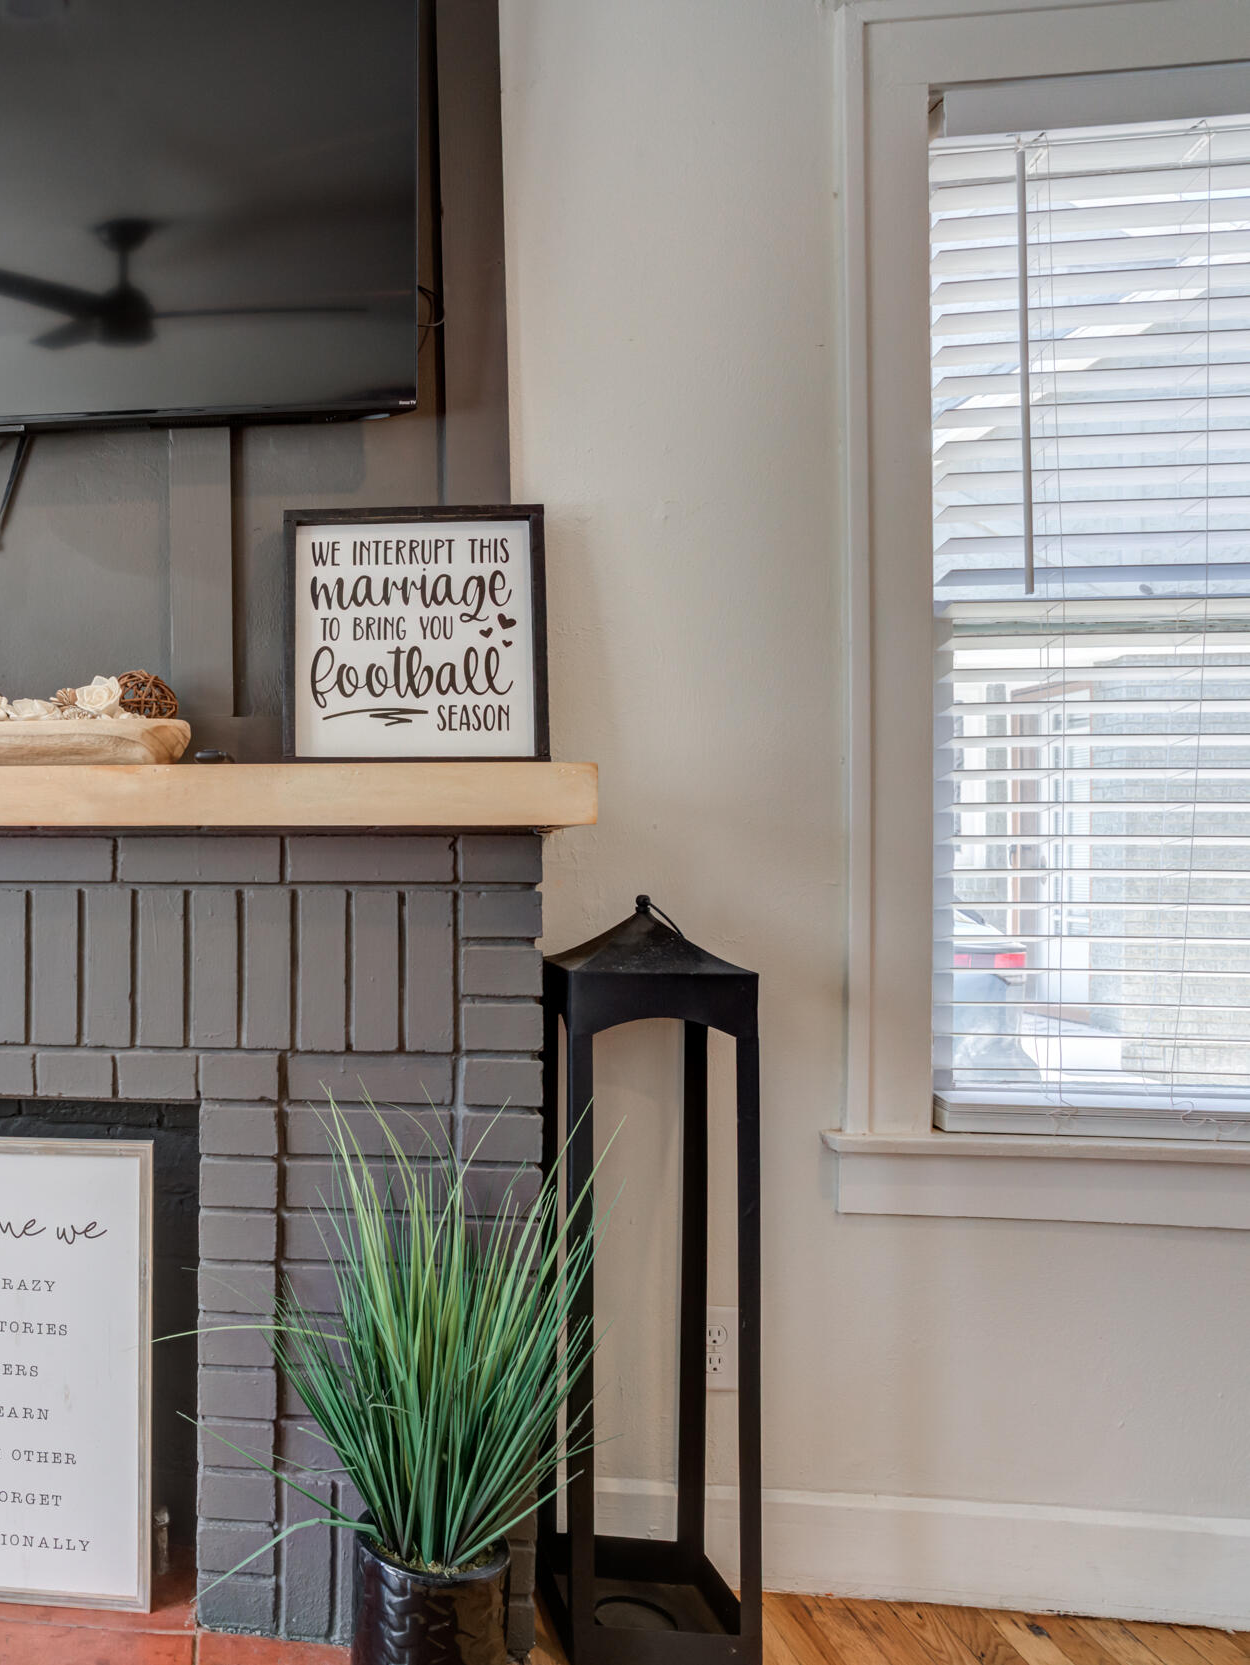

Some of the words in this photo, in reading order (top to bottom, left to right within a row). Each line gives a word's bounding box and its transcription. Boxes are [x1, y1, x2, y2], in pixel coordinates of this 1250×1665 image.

[311, 541, 341, 567] WE
[352, 538, 456, 566] INTERRUPT
[467, 537, 510, 564] THIS
[310, 567, 514, 625] marriage
[320, 616, 341, 642] TO
[352, 615, 407, 642] BRING
[419, 615, 454, 641] YOU
[310, 644, 514, 710] football
[436, 703, 510, 732] SEASON
[56, 1220, 108, 1246] we
[11, 1448, 77, 1465] OTHER
